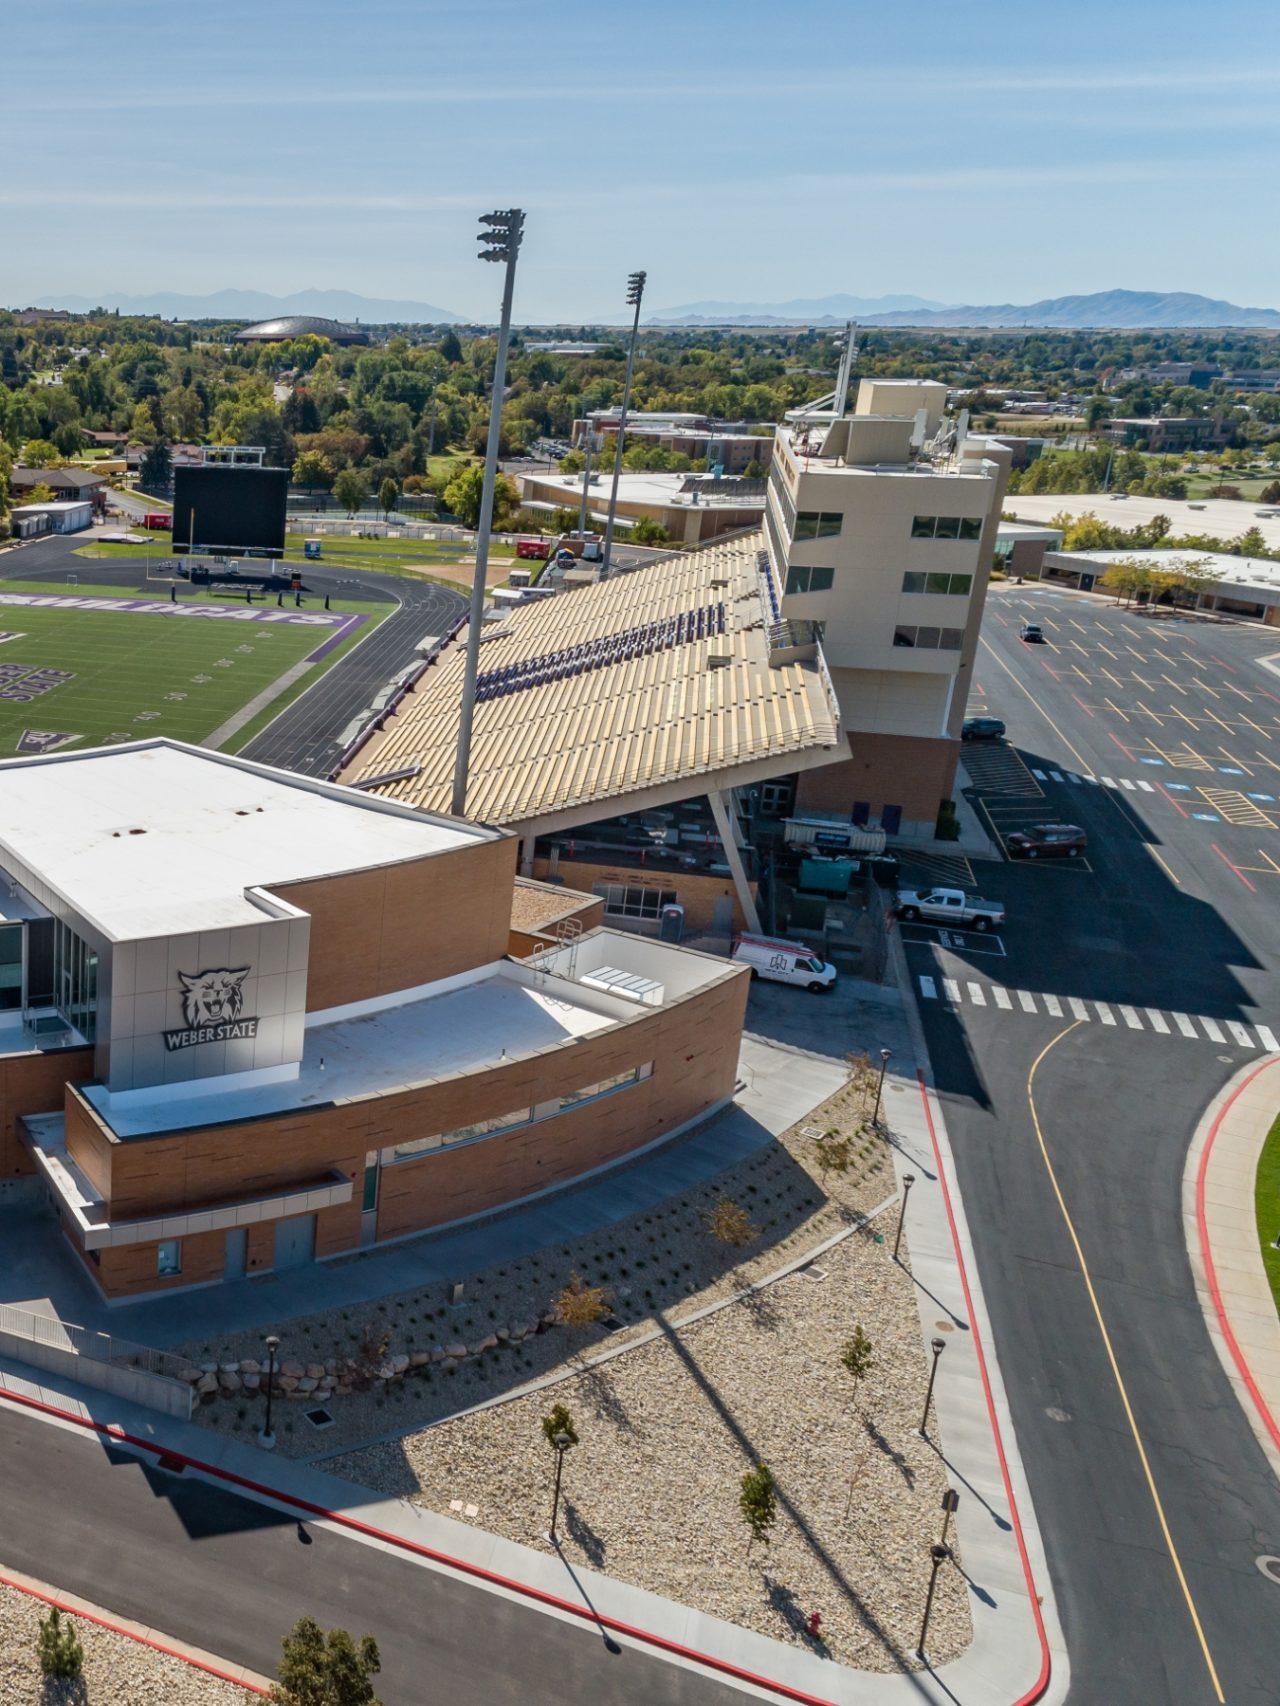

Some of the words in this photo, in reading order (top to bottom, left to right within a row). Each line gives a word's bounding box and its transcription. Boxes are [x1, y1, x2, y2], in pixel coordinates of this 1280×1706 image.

[29, 596, 345, 625] WILDCATS
[168, 1028, 215, 1050] WEBER
[217, 1022, 256, 1039] STATE
